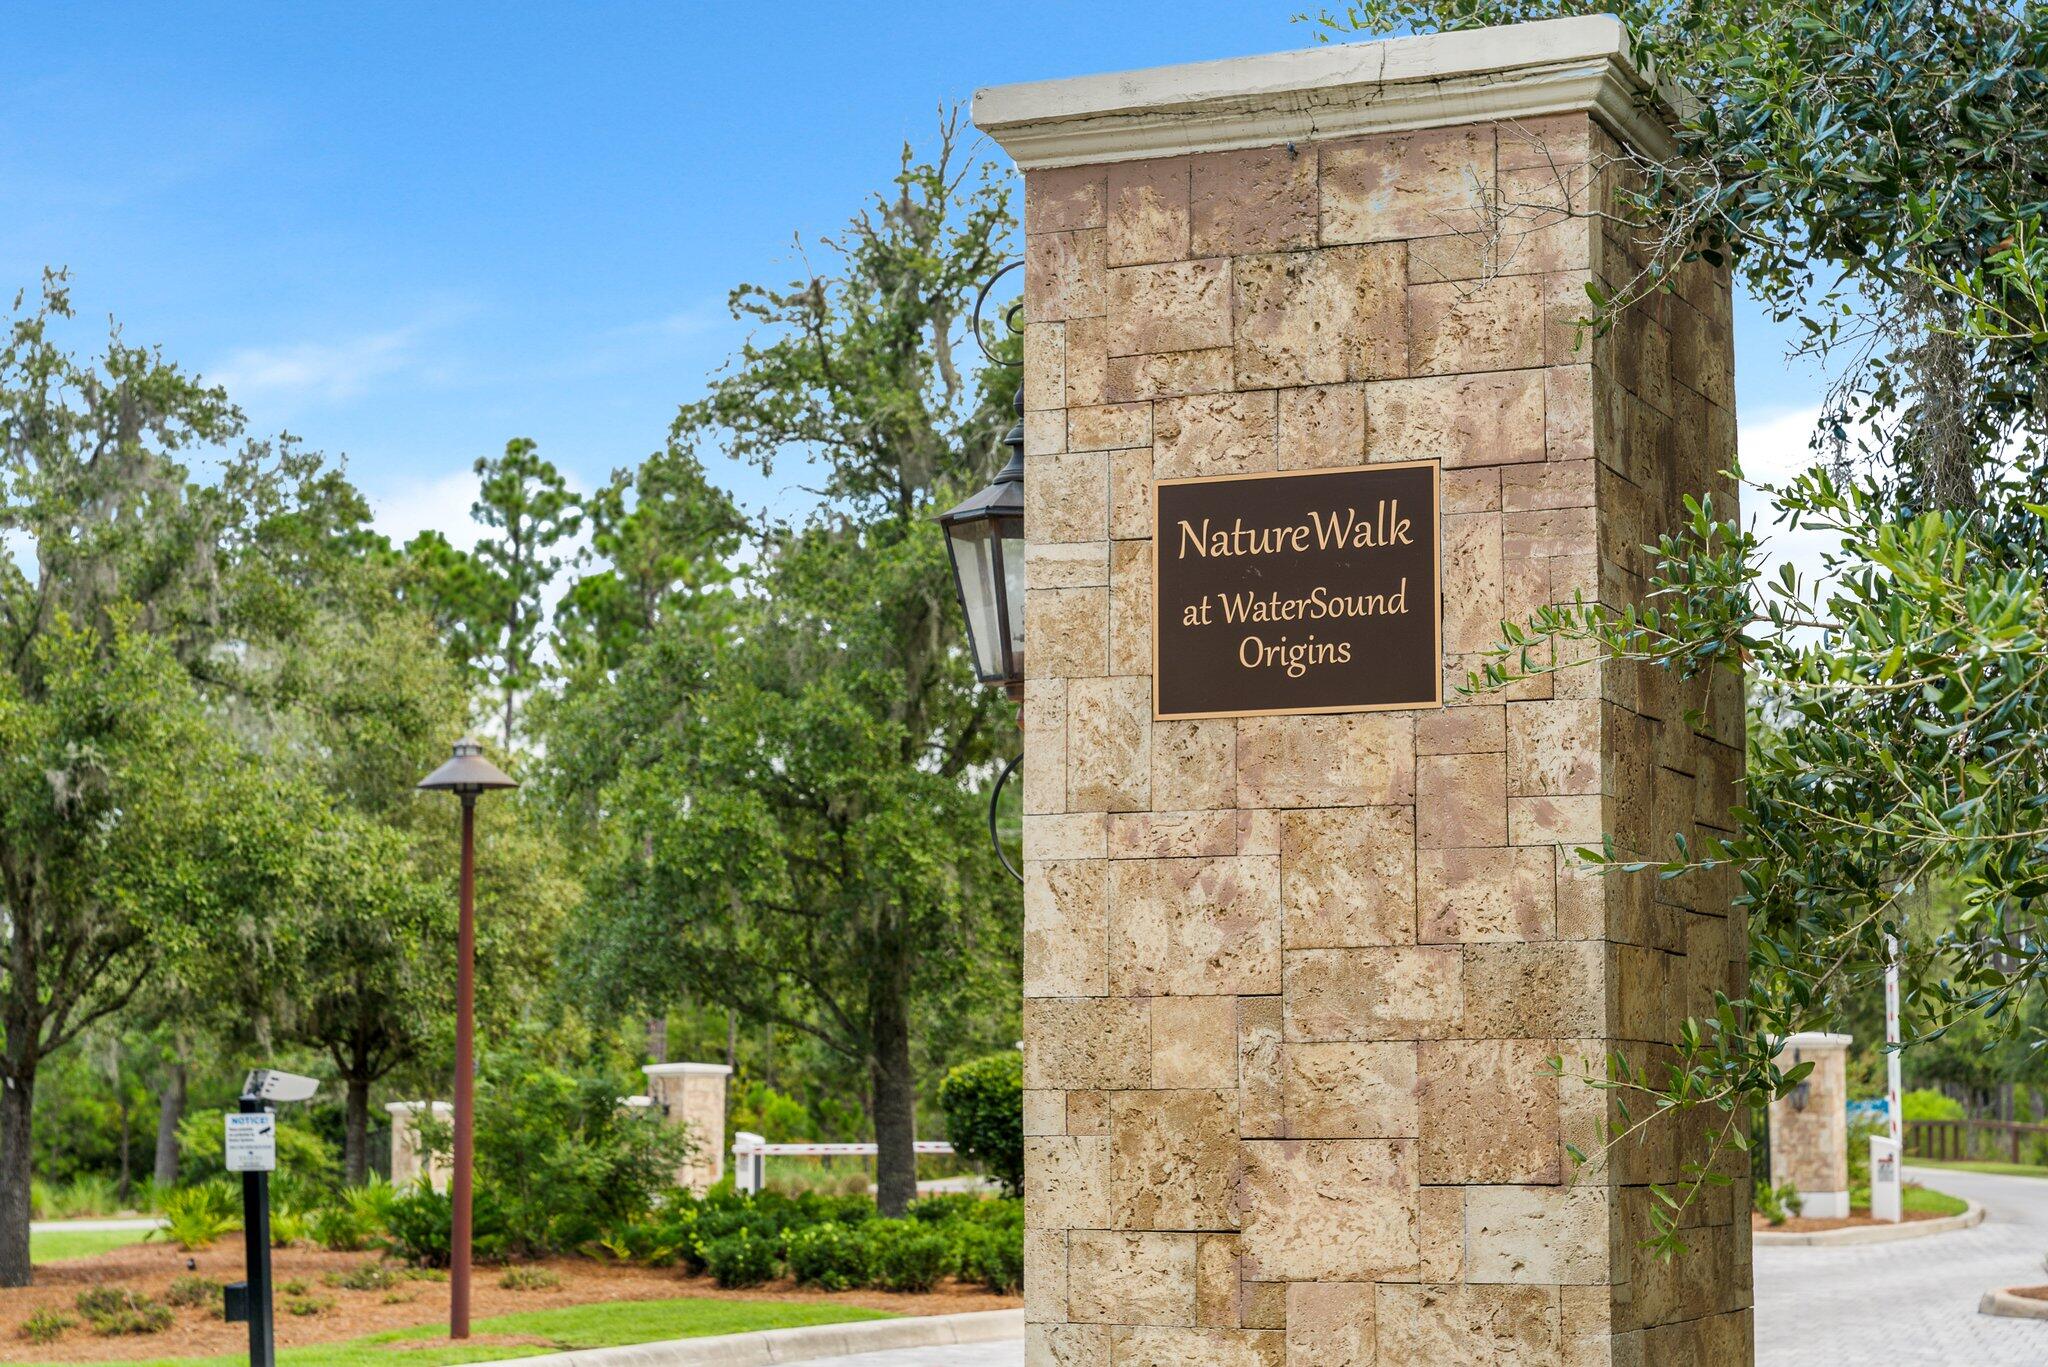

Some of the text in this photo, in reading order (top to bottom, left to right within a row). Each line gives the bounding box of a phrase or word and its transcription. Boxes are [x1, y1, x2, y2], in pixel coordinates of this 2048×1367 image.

[1177, 499, 1414, 560] NatureWalk
[1182, 577, 1409, 627] at WaterSound
[1239, 634, 1351, 678] Origins
